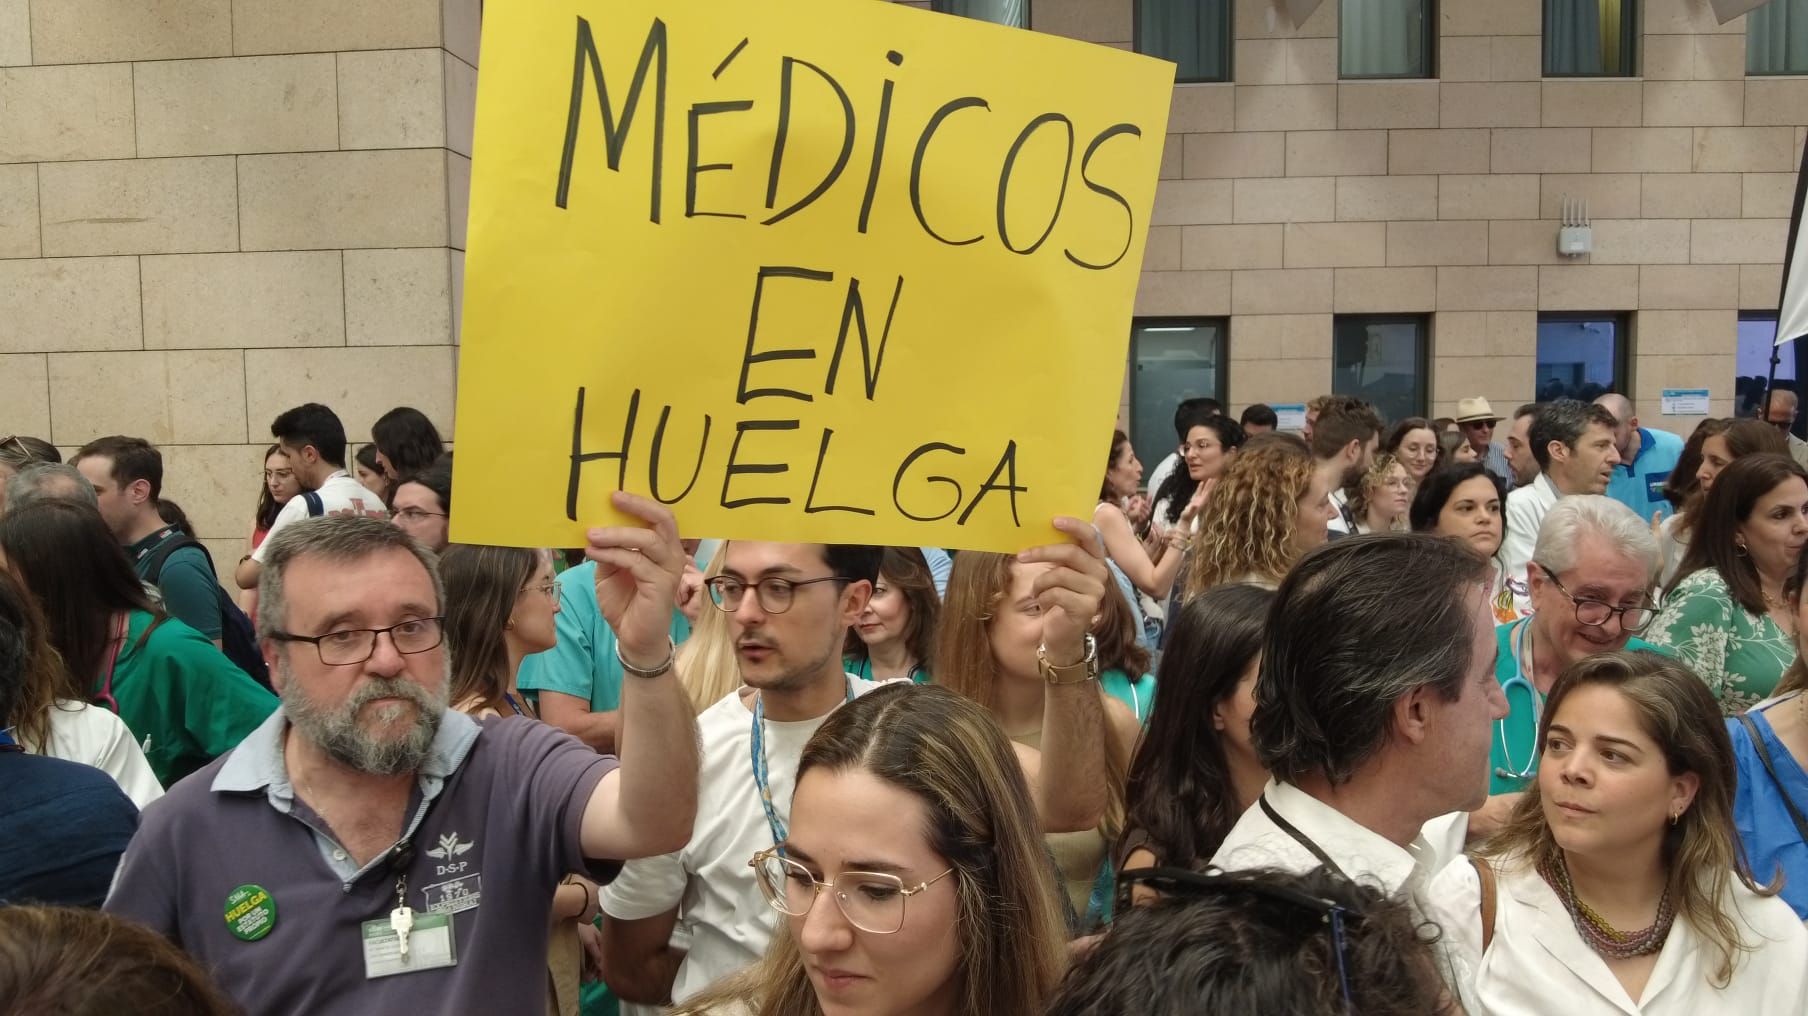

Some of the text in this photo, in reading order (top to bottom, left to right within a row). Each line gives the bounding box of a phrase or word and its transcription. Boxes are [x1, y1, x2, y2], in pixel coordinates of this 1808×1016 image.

[736, 266, 904, 405] EN
[567, 386, 1028, 528] HUELGA
[224, 891, 267, 923] HUELGA
